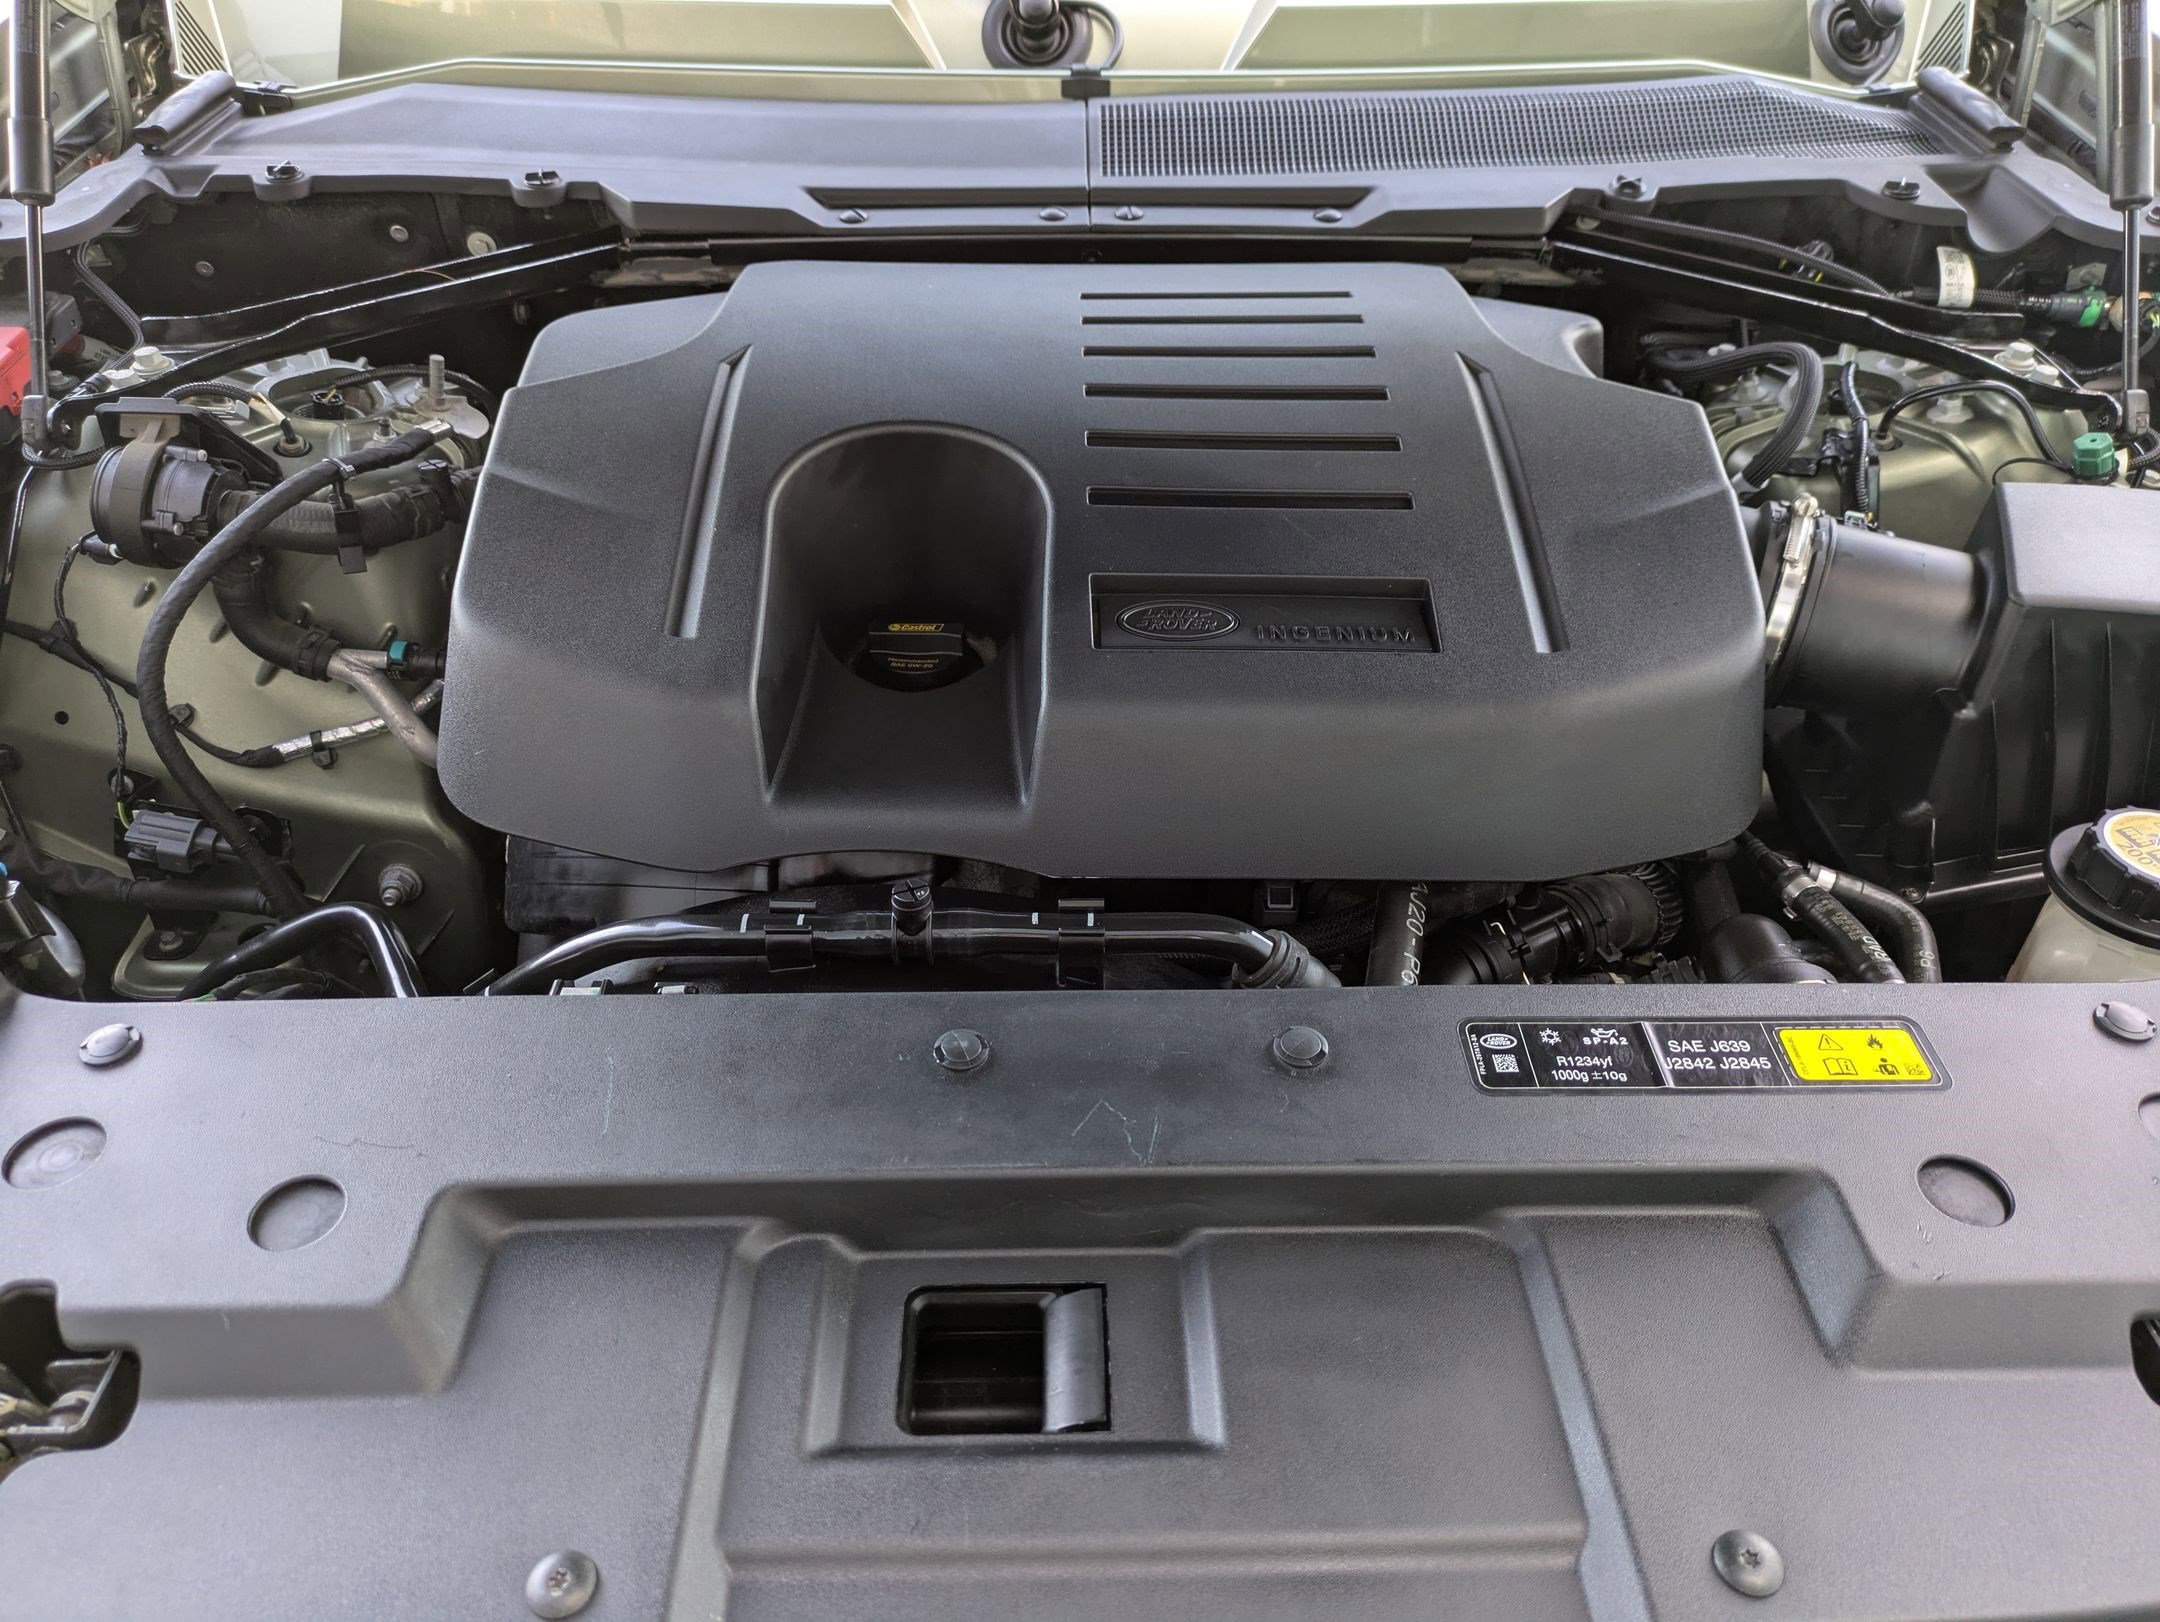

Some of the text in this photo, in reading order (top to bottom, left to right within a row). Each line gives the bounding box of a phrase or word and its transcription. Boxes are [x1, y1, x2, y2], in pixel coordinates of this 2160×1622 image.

[1143, 606, 1203, 619] LAND
[901, 623, 937, 632] Castrol
[1147, 617, 1218, 631] ROVER
[1256, 624, 1416, 643] INGENIUM
[1583, 1037, 1629, 1045] SP-A2
[1667, 1040, 1751, 1053] SAE J639
[1556, 1056, 1613, 1068] R1234yf
[1664, 1057, 1772, 1070] J2842 J2845
[1551, 1070, 1628, 1082] 1000g ±10g
